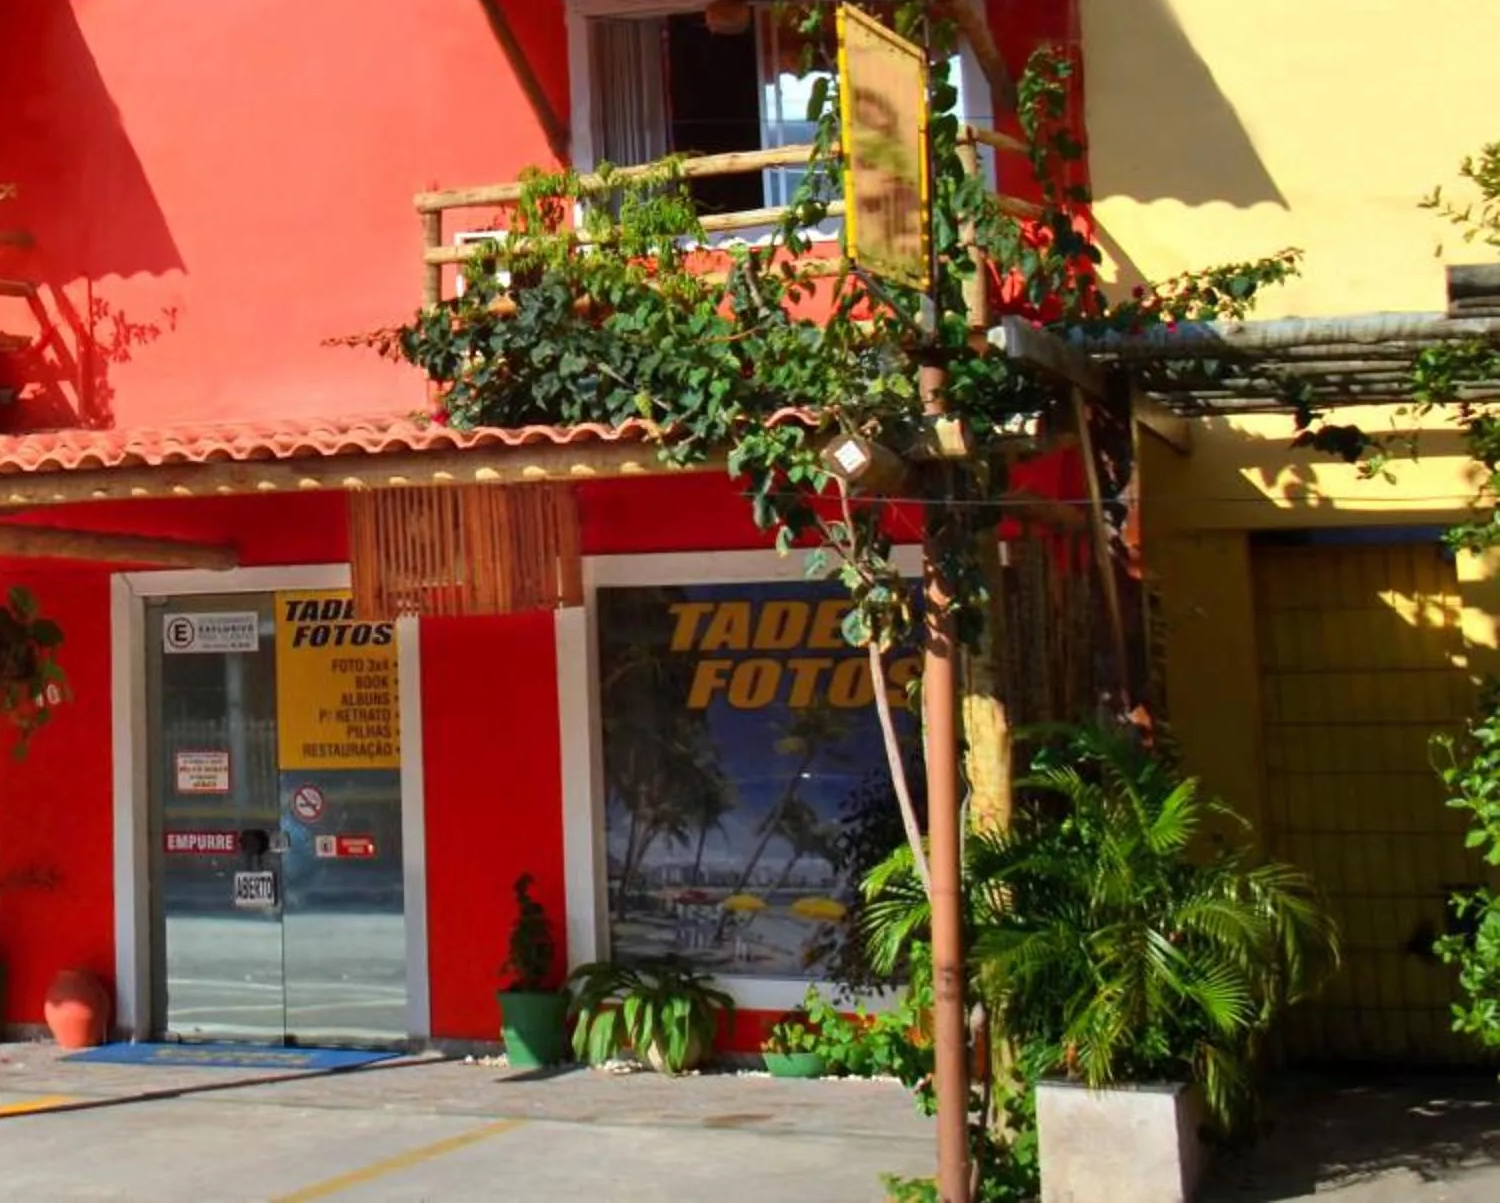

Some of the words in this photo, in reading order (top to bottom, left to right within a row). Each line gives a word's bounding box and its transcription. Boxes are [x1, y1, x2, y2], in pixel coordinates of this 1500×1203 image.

[175, 624, 188, 642] E
[668, 599, 850, 652] TADE
[292, 623, 394, 647] FOTOS
[331, 658, 364, 673] FOTO
[355, 676, 389, 690] BOOK
[336, 709, 392, 723] RETRATO
[347, 725, 392, 739] PILHAS
[302, 740, 393, 759] RESTAURAÇÃO
[167, 834, 234, 851] EMPURRE
[237, 876, 272, 900] ABERTO
